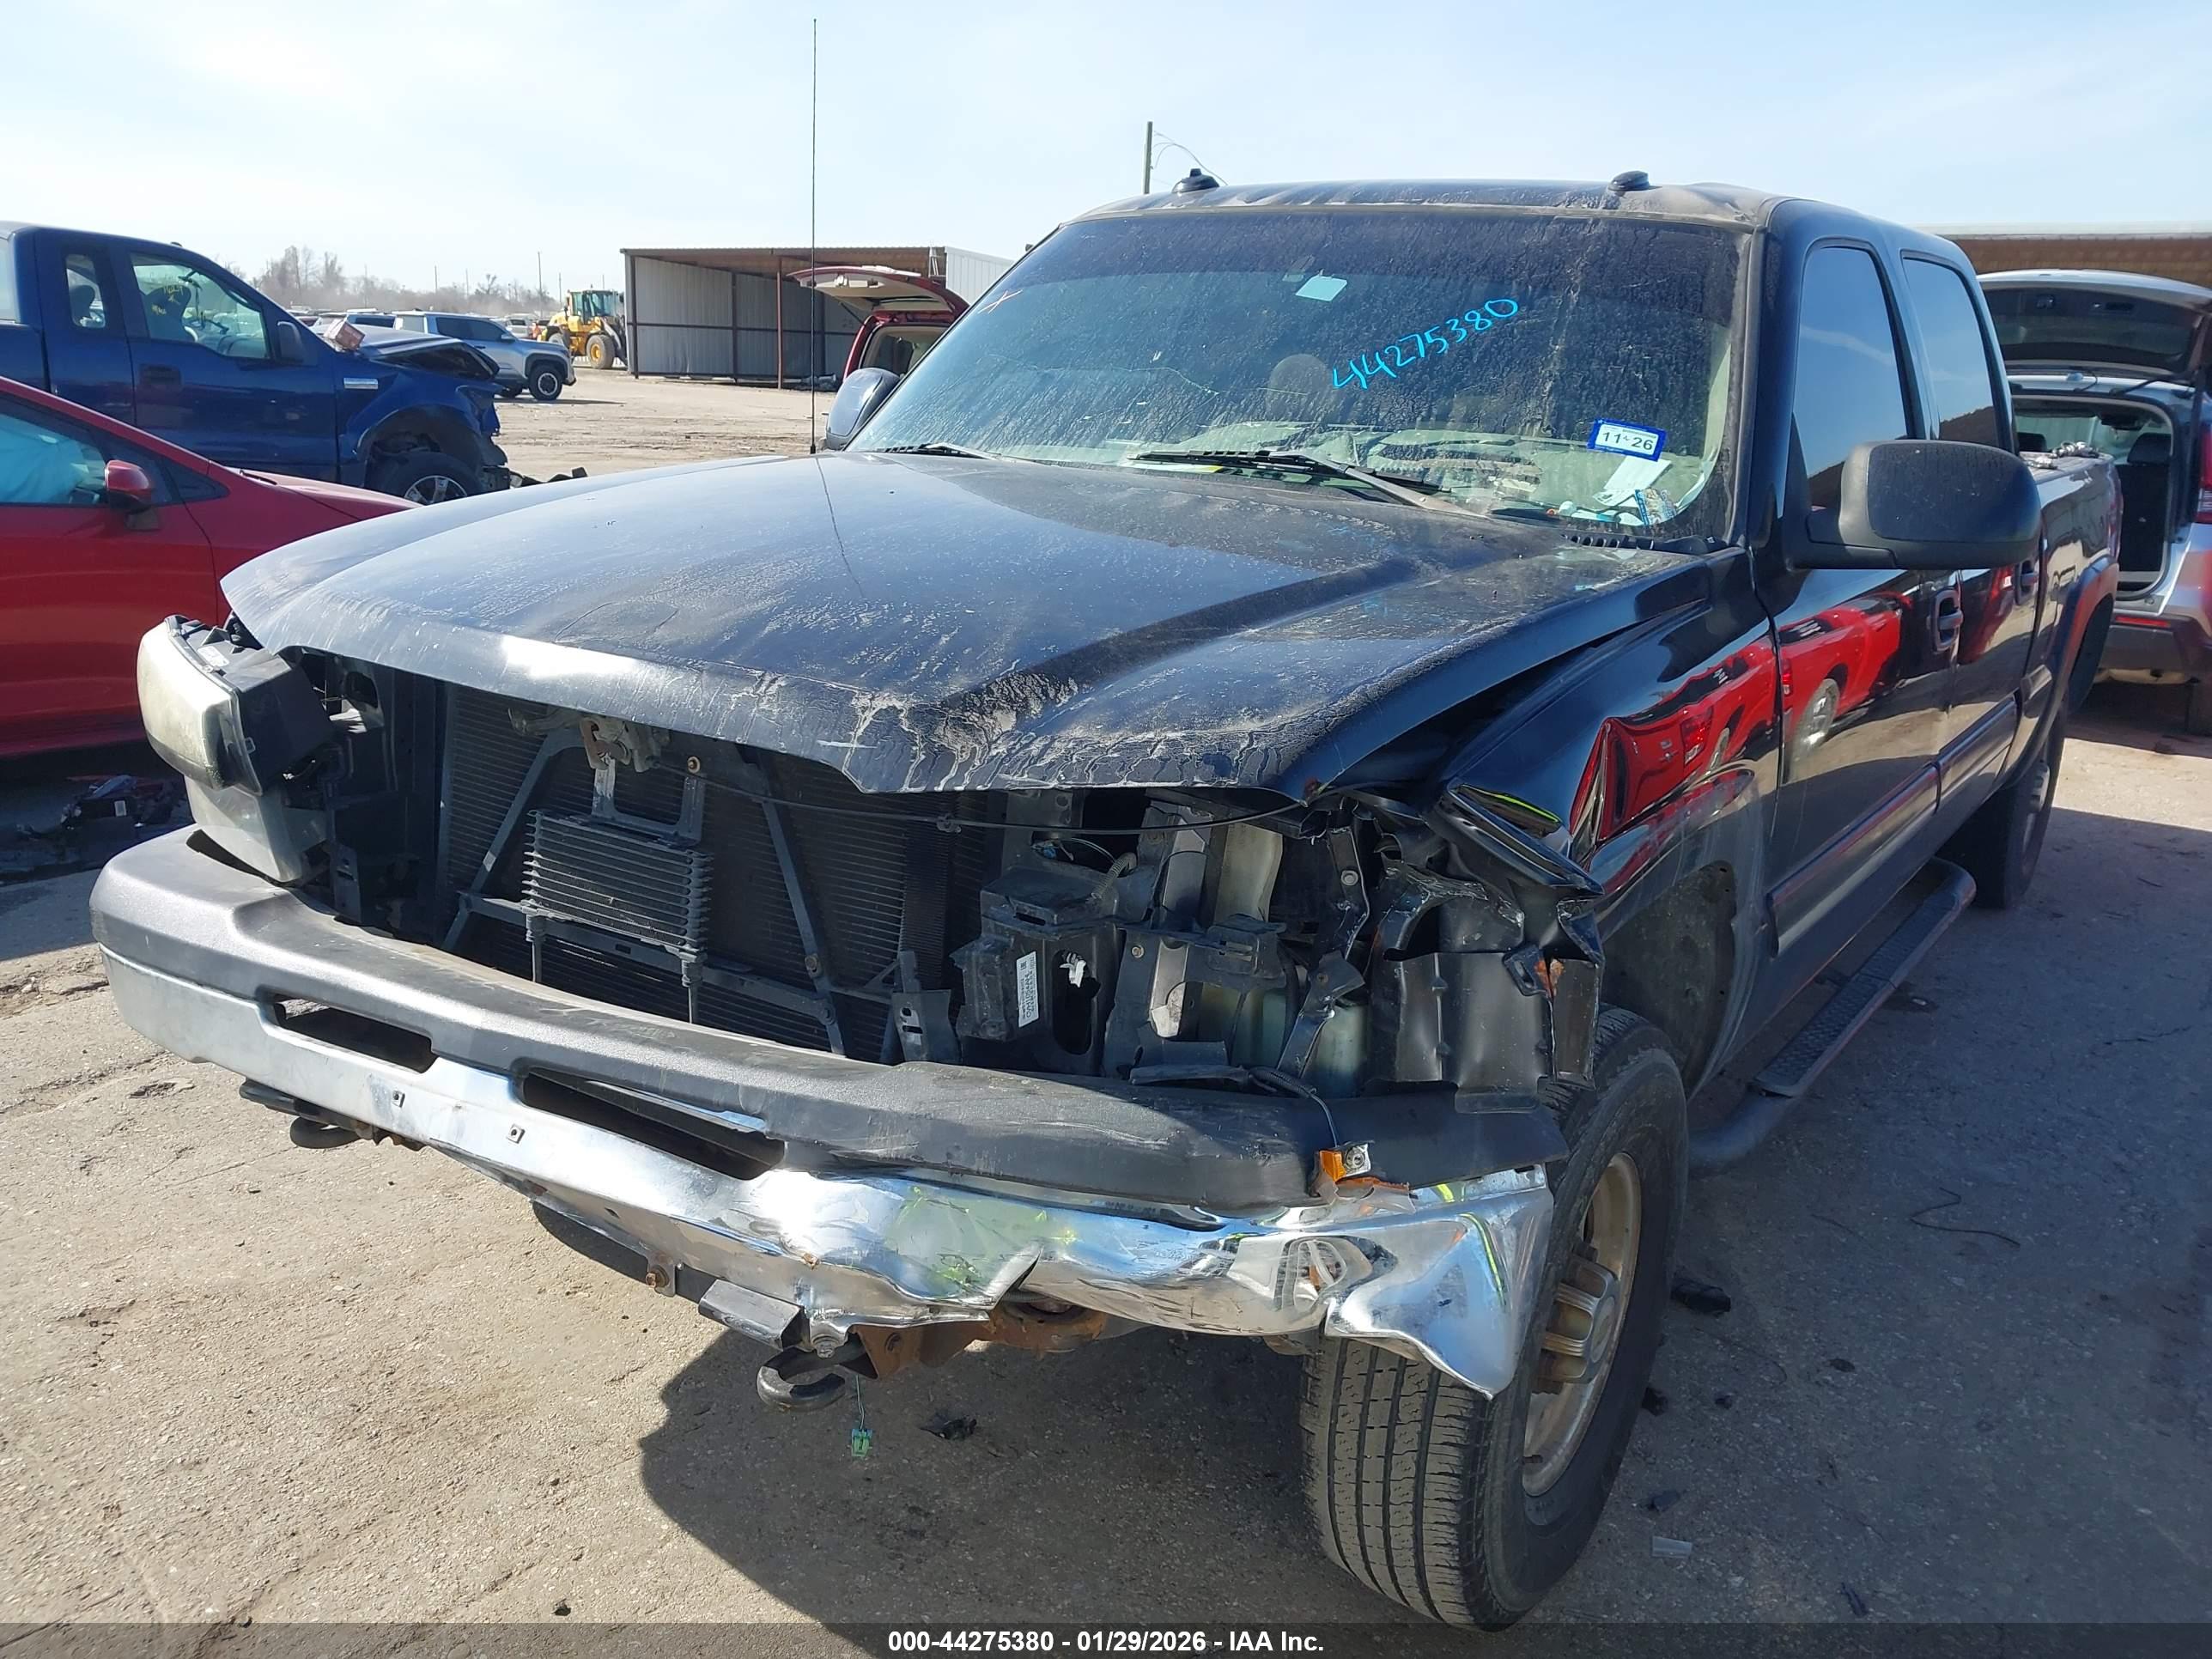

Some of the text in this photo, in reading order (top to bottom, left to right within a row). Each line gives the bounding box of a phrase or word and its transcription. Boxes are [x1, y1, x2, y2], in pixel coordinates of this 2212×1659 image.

[1333, 299, 1518, 389] 44275380
[1602, 431, 1621, 443] 11
[1631, 436, 1654, 450] 26
